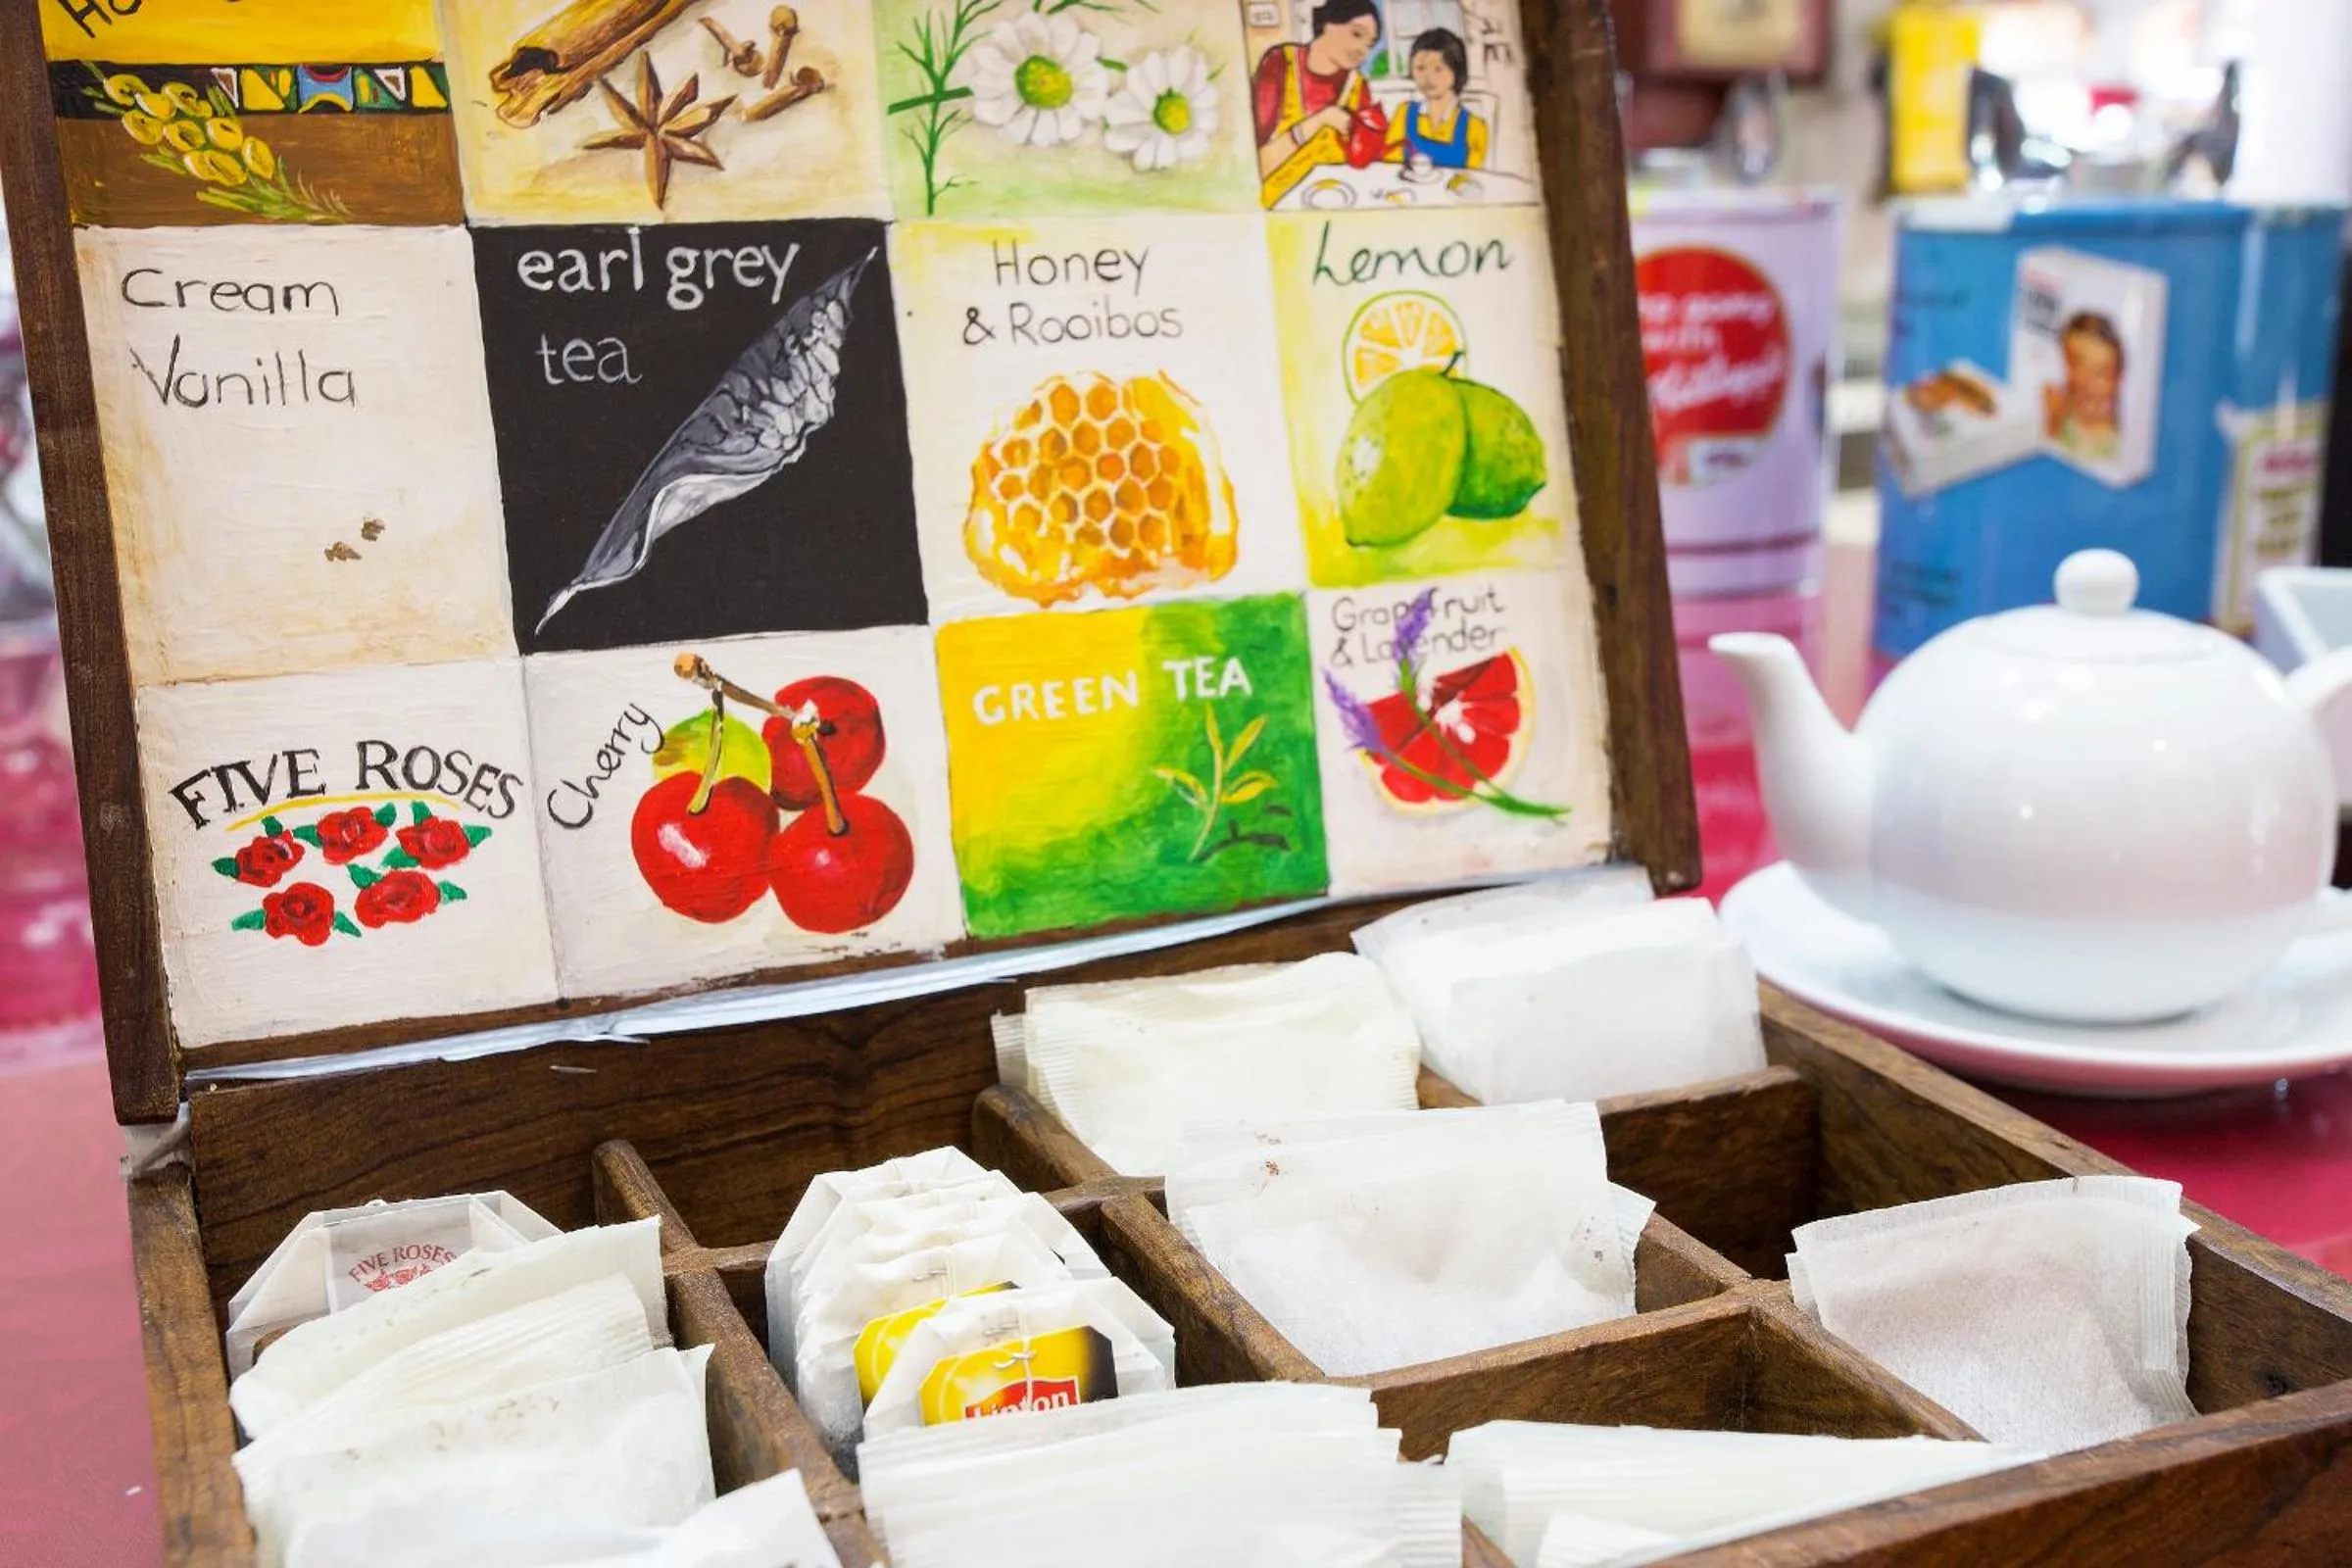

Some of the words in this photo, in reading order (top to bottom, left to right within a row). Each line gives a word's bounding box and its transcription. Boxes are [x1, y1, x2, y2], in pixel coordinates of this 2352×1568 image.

[516, 226, 643, 293] earl
[666, 243, 800, 311] grey
[994, 239, 1150, 296] Honey
[1312, 220, 1513, 286] Lemon
[122, 268, 340, 317] Cream
[962, 307, 995, 345] &
[1010, 298, 1184, 345] Rooibos
[130, 334, 356, 408] Vanilla
[535, 333, 642, 385] tea
[1331, 588, 1505, 632] Grapfruit
[1331, 637, 1354, 668] &
[1361, 617, 1504, 663] Laender
[972, 670, 1140, 725] GREEN
[1163, 657, 1252, 701] TEA
[169, 749, 325, 831] FIVE
[355, 740, 525, 820] ROSES
[547, 702, 665, 830] Cherry
[348, 1251, 388, 1283] FIVE
